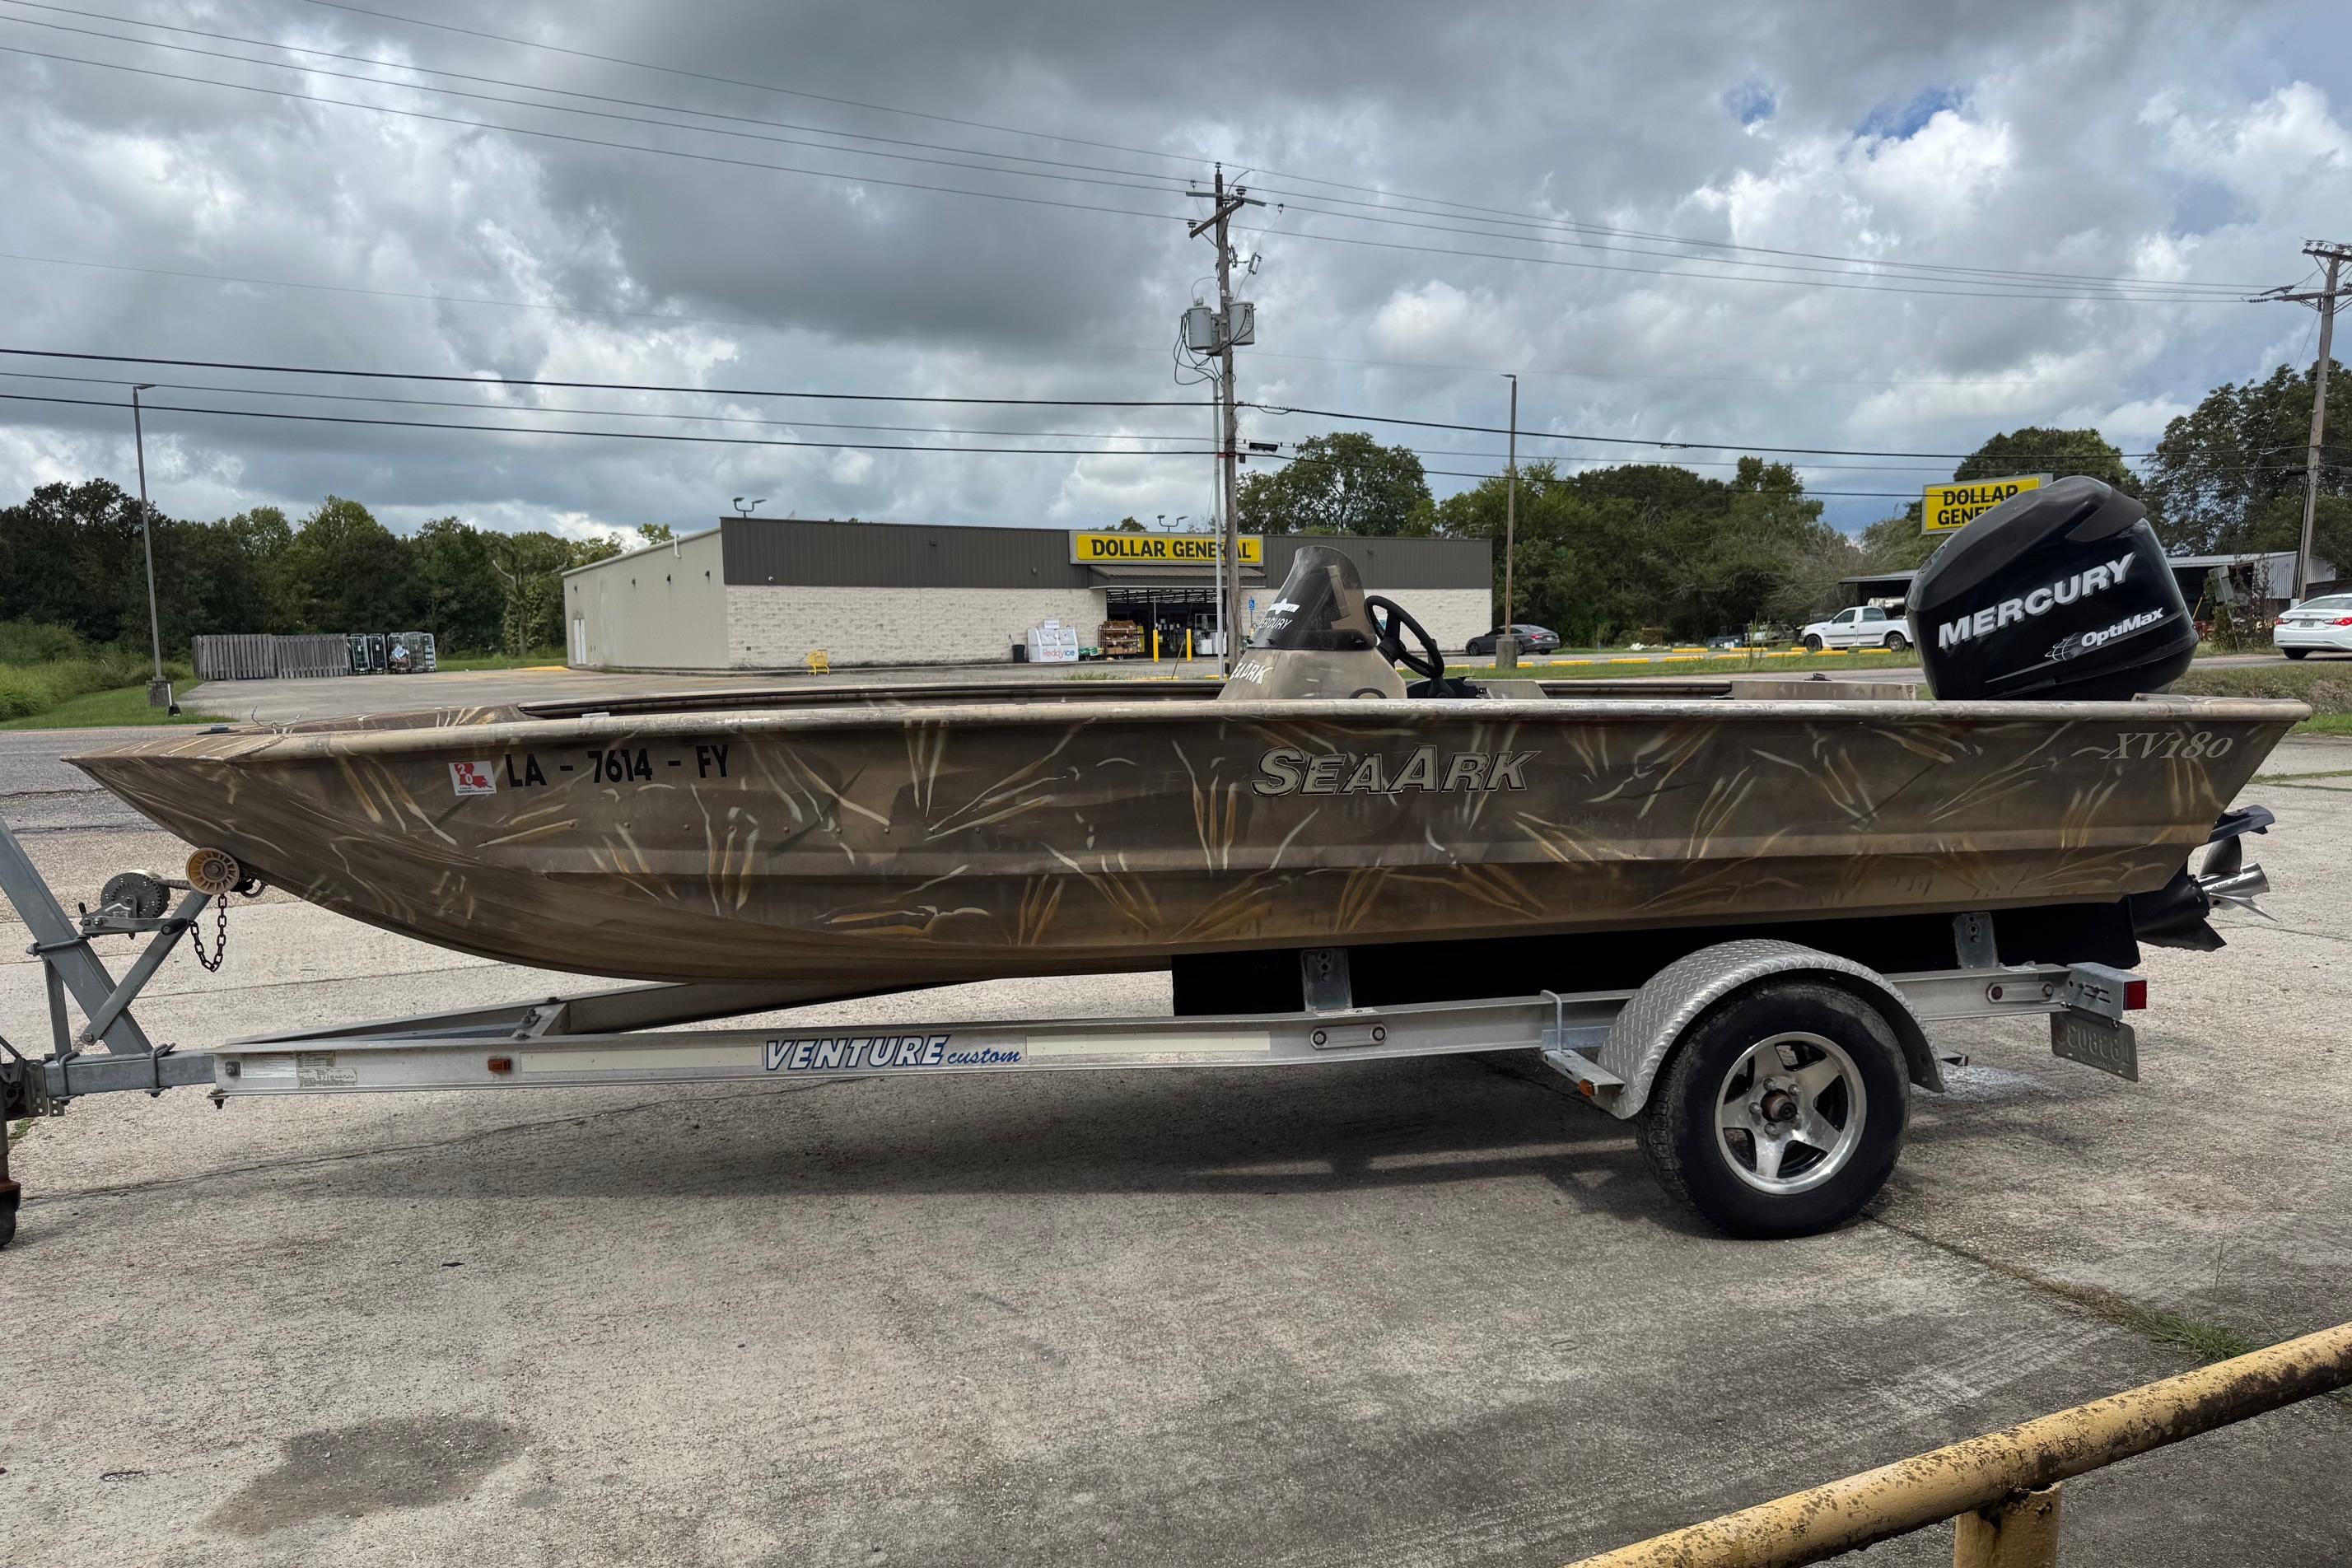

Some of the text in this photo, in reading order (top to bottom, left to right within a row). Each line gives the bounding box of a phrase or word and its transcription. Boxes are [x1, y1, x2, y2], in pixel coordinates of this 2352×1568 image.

[1938, 506, 1994, 525] GENE
[1091, 539, 1166, 558] DOLLAR
[1938, 552, 2135, 649] MERCURY
[1259, 618, 1292, 630] ERCURY
[2080, 607, 2164, 646] OptiMax
[1230, 662, 1273, 685] EAARK
[2100, 731, 2233, 758] XV180
[505, 754, 547, 787] LA
[587, 748, 653, 783] 7614
[696, 744, 729, 778] FY
[766, 1034, 1023, 1071] VENTURE custom
